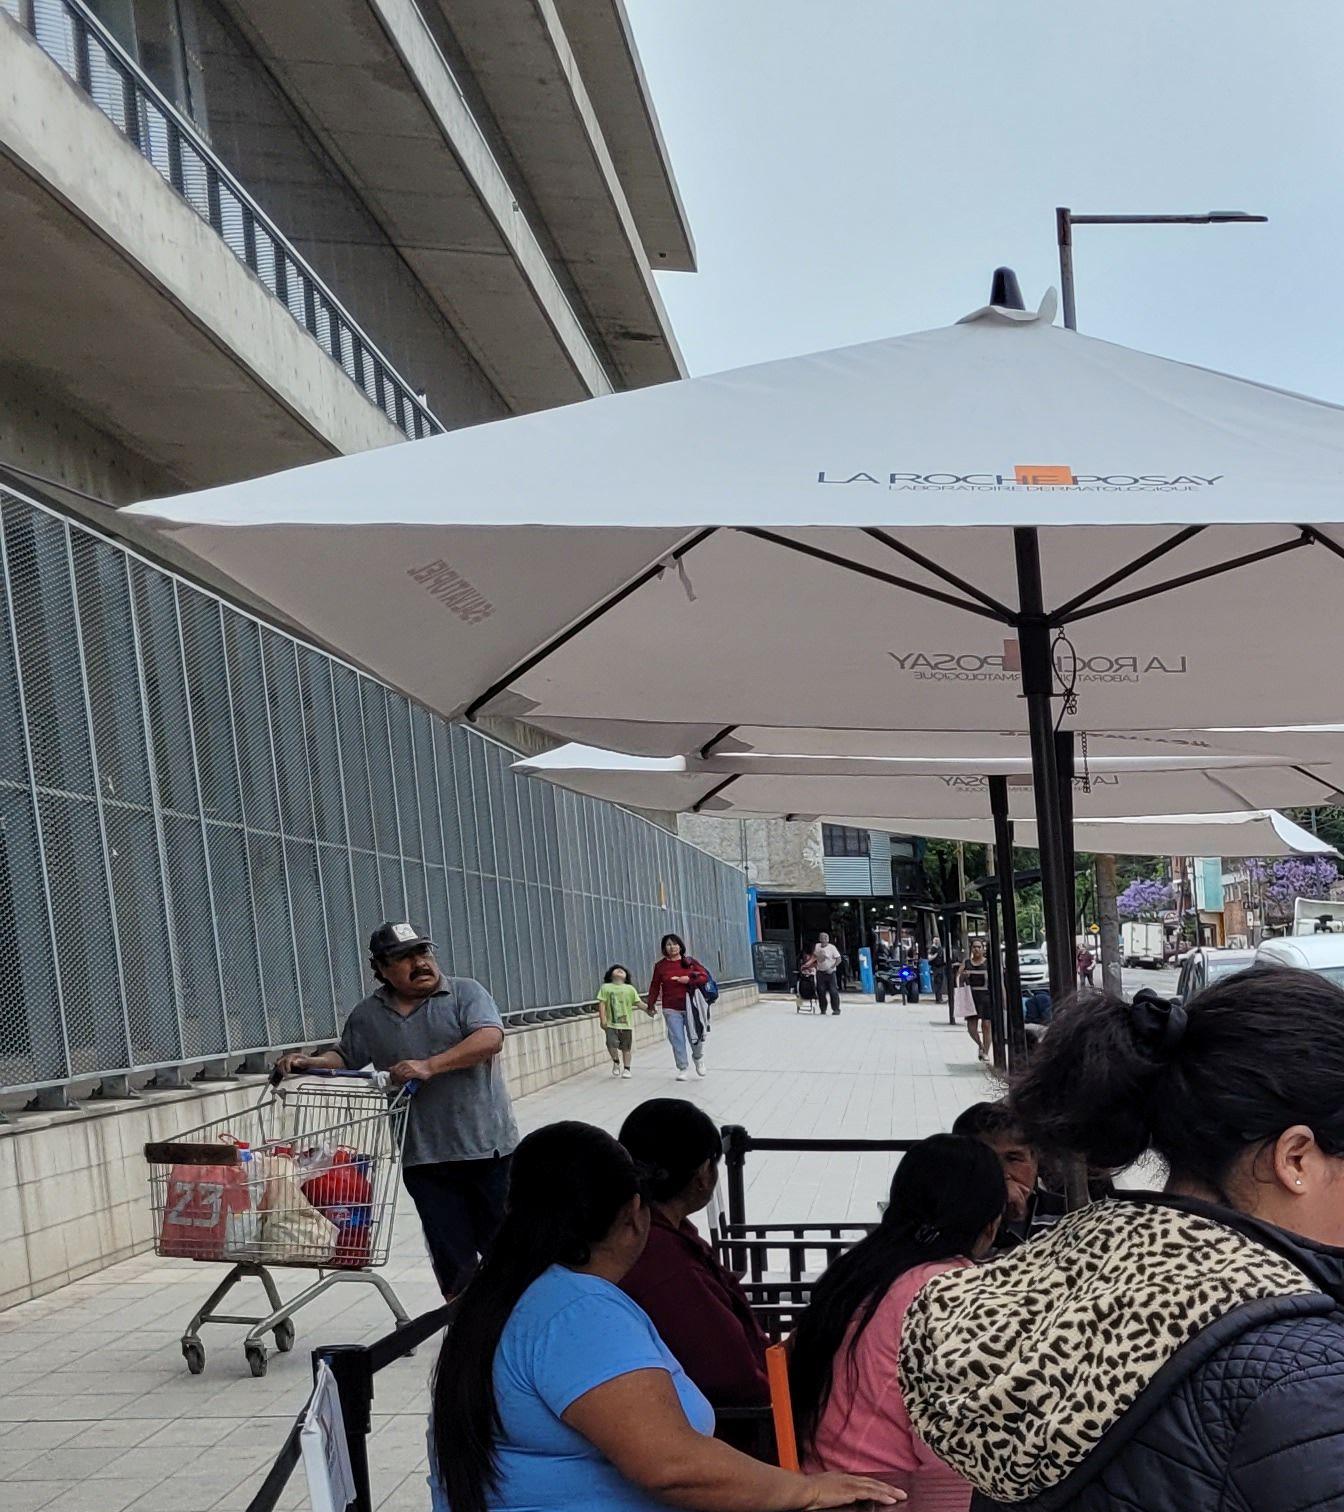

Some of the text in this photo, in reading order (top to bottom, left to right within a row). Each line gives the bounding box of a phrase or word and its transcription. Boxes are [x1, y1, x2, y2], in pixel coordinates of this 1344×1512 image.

[817, 471, 1224, 486] LA ROCHE POSAY
